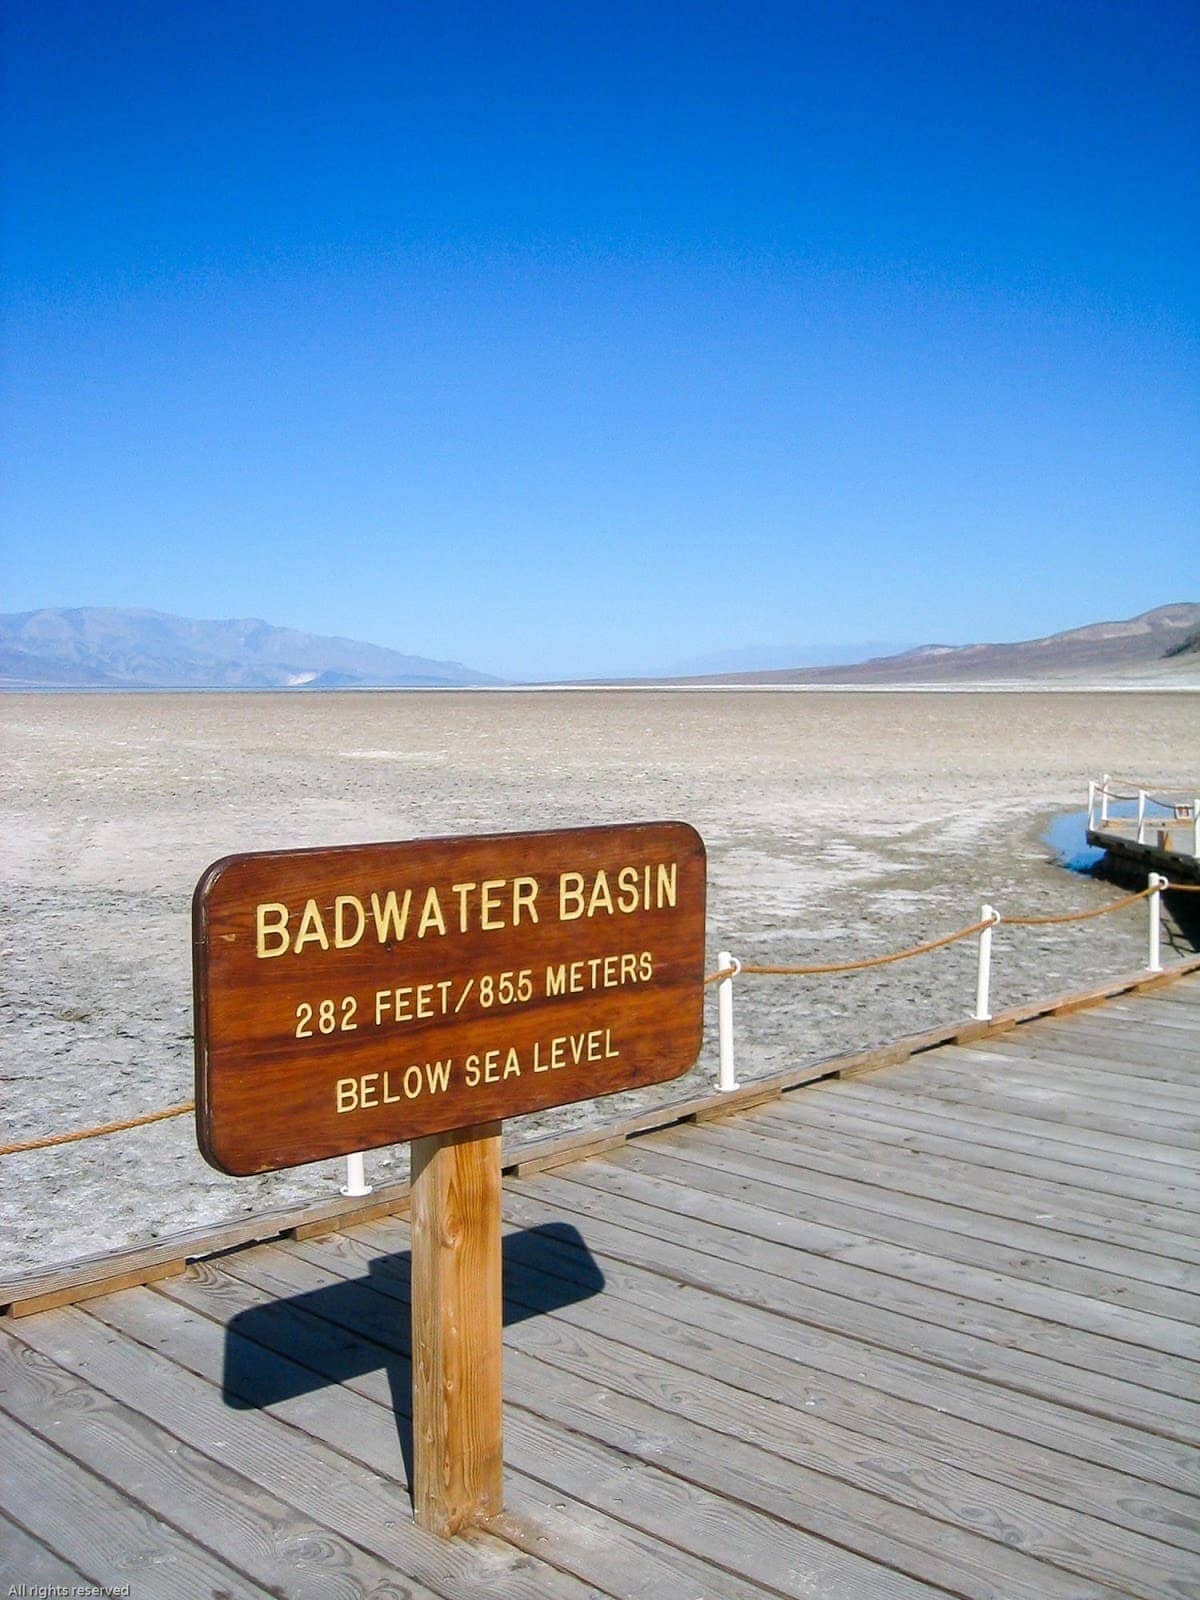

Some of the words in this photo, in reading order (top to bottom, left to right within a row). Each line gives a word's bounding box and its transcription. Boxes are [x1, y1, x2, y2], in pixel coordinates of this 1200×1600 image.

[255, 876, 540, 959] BADWATER
[559, 863, 677, 921] BASIN
[295, 996, 358, 1038] 282
[546, 951, 653, 997] METERS
[336, 1059, 452, 1113] BELOW
[465, 1047, 521, 1088] SEA
[533, 1028, 620, 1073] LEVEL
